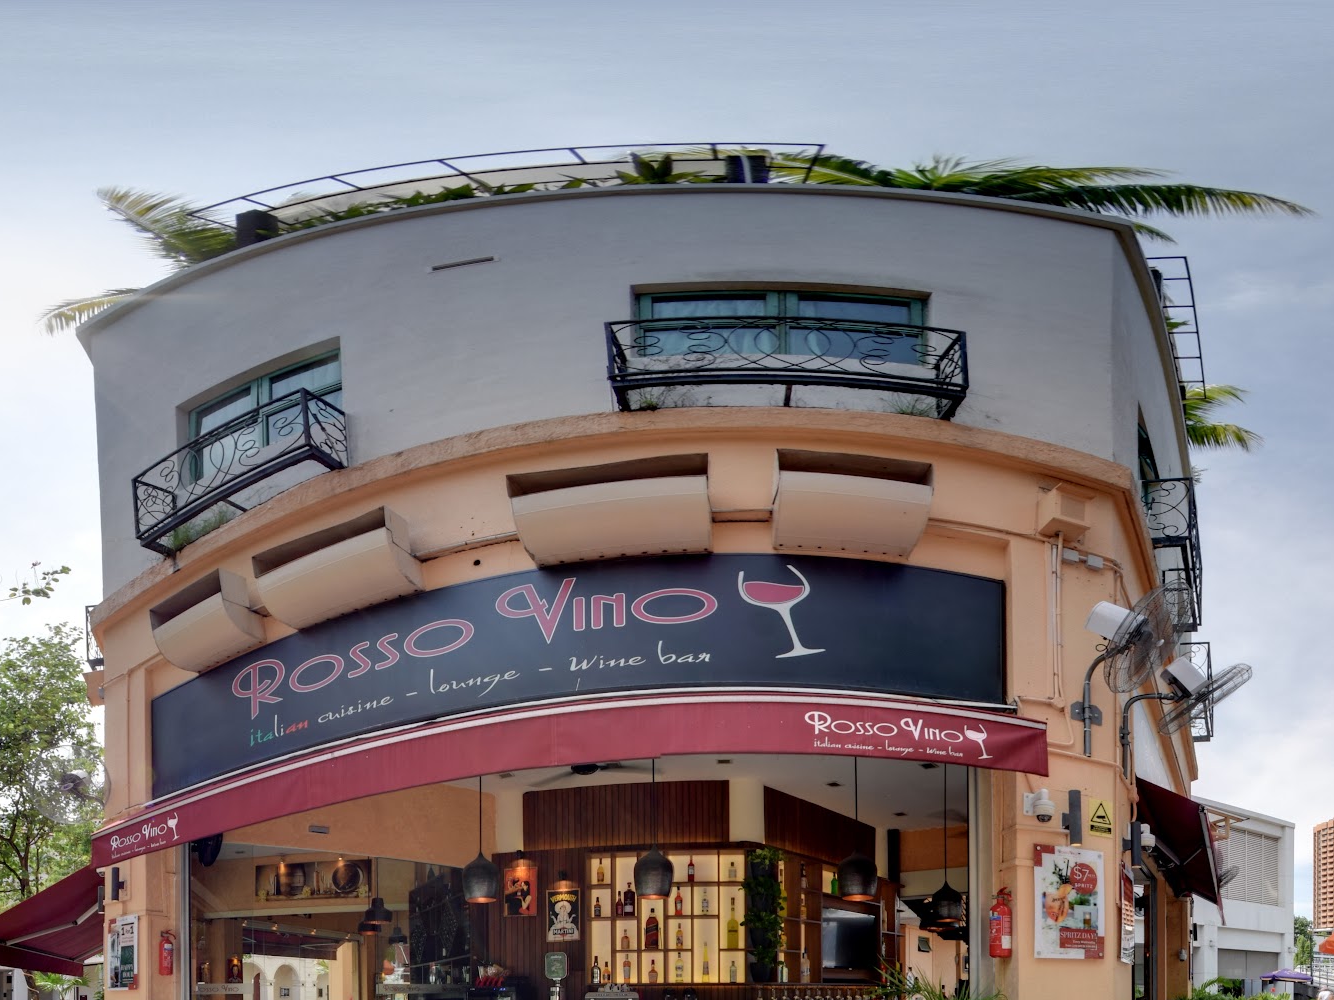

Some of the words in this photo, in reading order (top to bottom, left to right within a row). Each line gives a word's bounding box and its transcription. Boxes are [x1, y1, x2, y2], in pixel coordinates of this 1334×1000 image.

[250, 714, 309, 747] italian
[317, 695, 394, 724] cuisine
[428, 668, 521, 697] lounge
[657, 640, 711, 665] bar
[814, 736, 841, 748] italian
